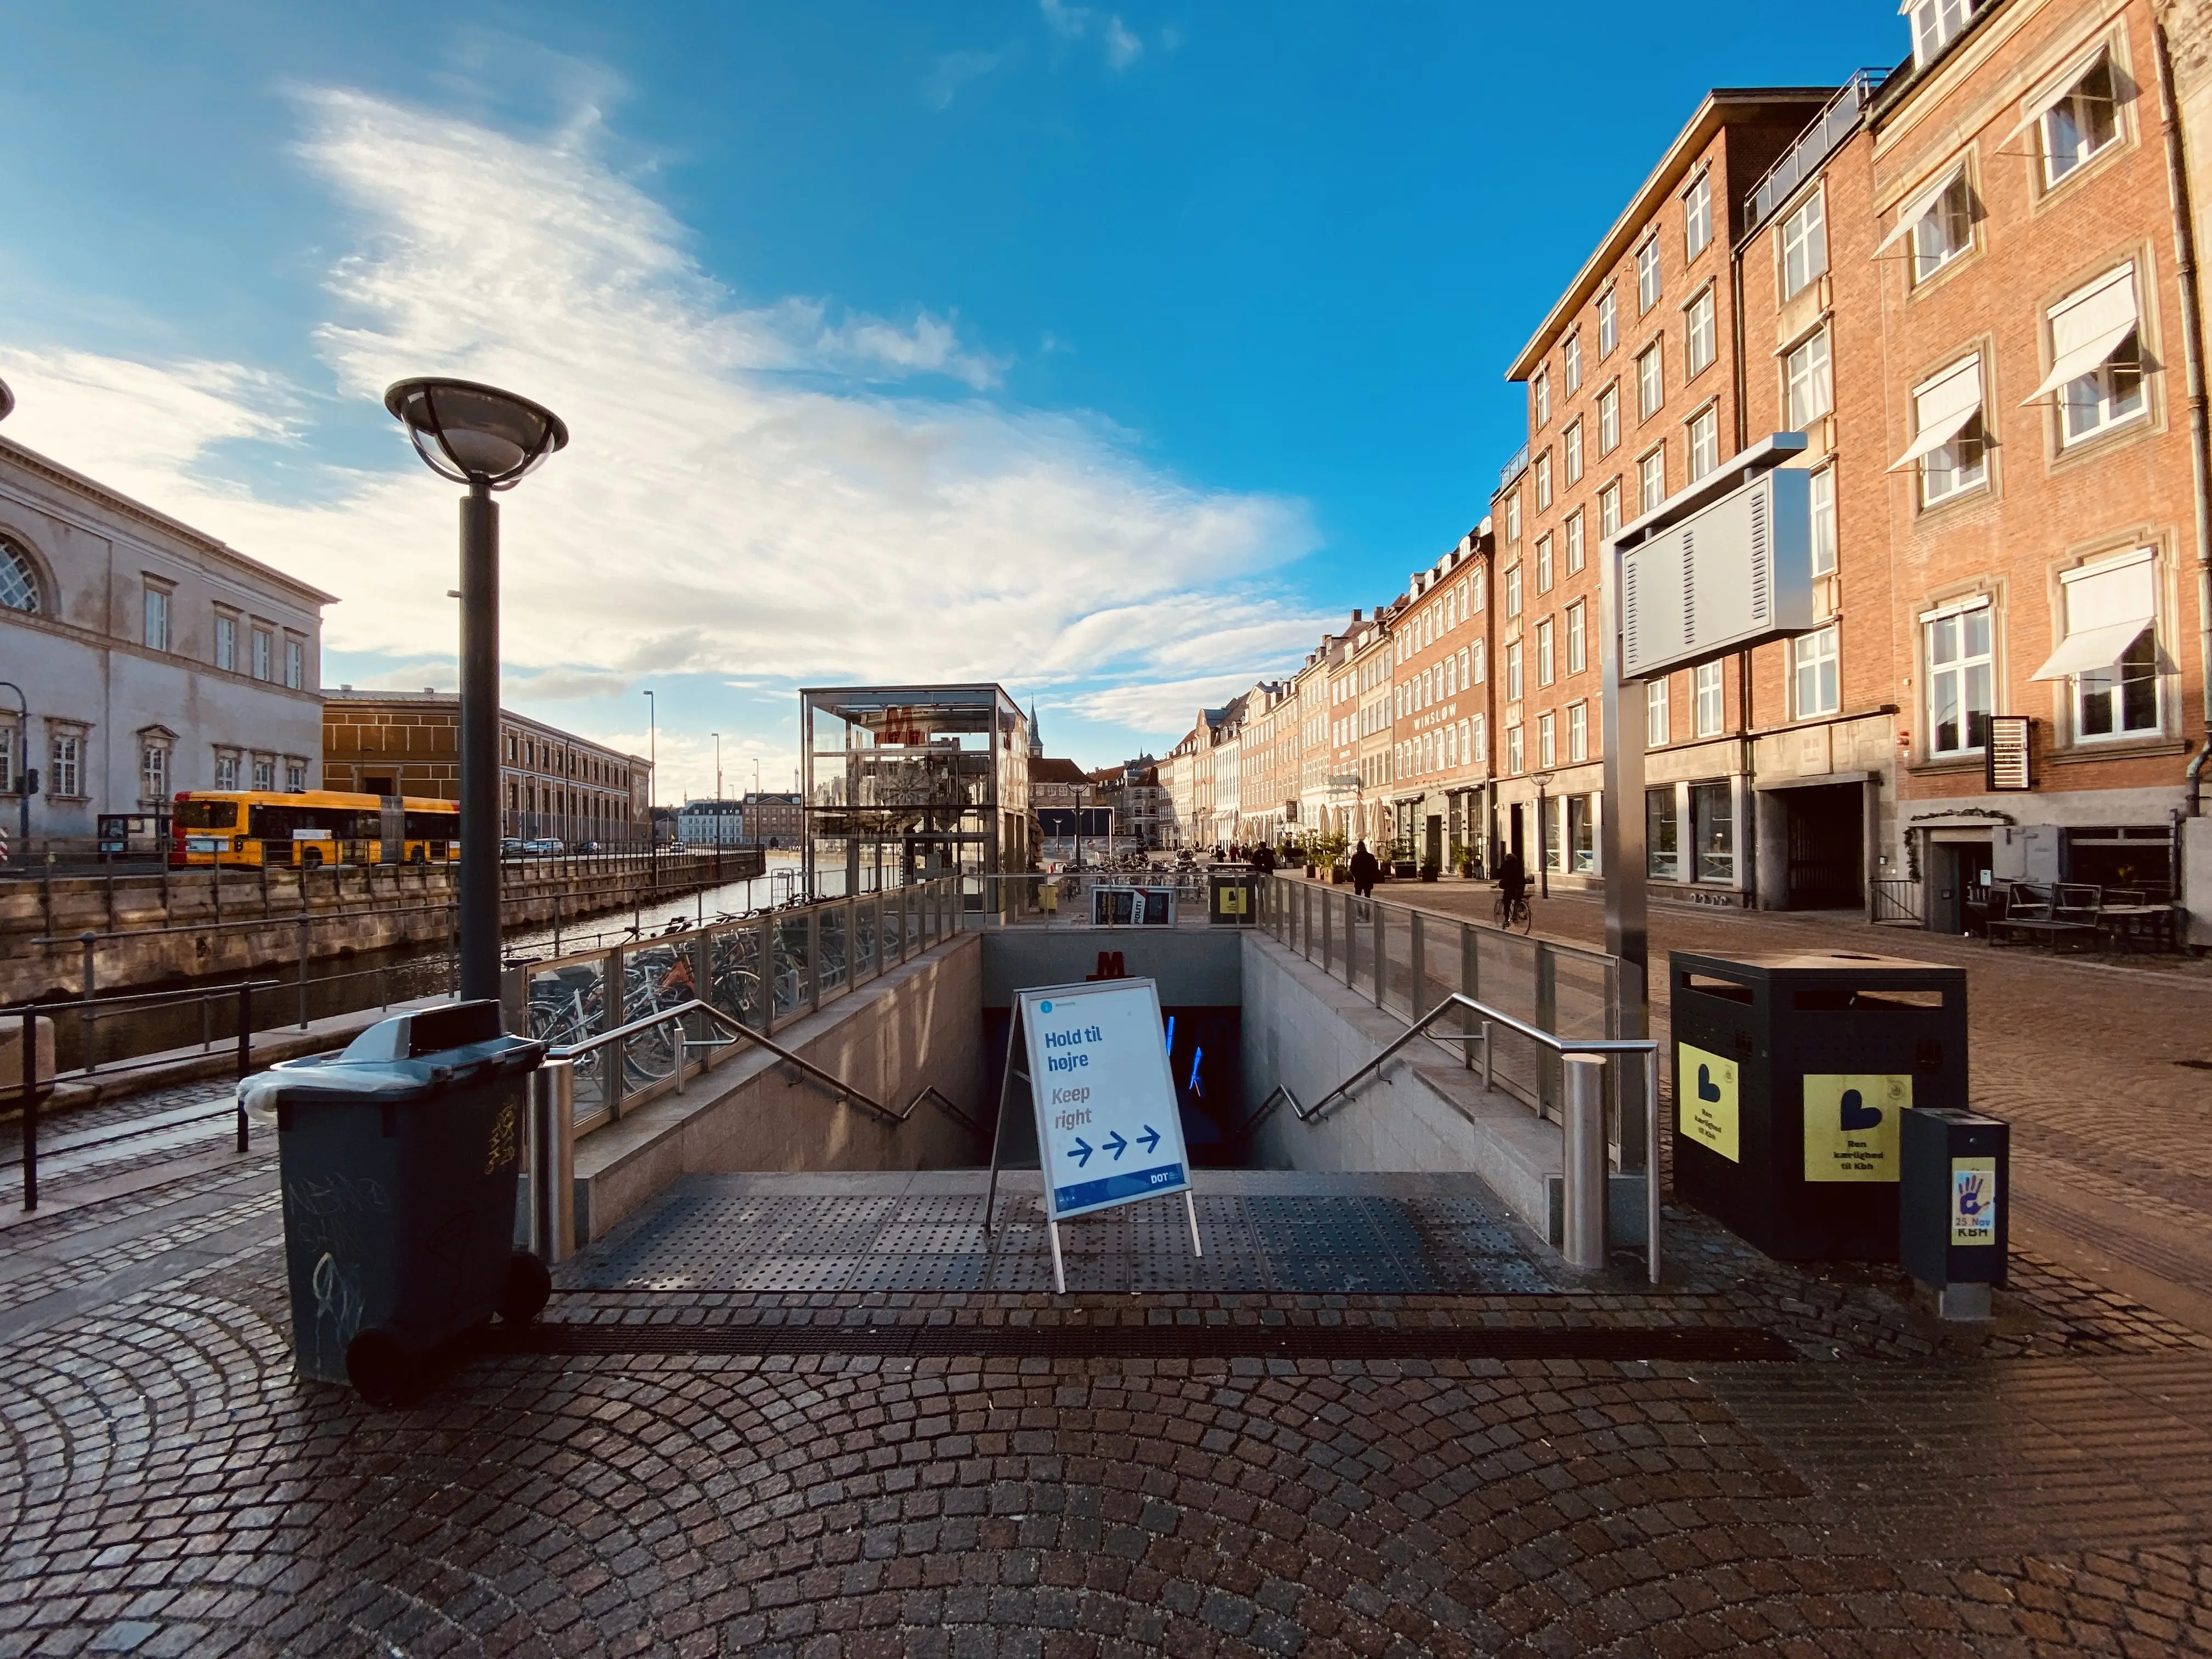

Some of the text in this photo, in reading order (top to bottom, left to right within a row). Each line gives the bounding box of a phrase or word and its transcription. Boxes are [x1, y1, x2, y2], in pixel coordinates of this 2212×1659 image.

[1413, 702, 1457, 731] WINSLØW
[1097, 951, 1125, 976] M
[1045, 1025, 1103, 1048] Hold til
[1048, 1052, 1089, 1072] højre
[1052, 1087, 1090, 1104] Keep
[1055, 1108, 1092, 1130] right
[1150, 1172, 1169, 1184] DOT
[1972, 1217, 1990, 1226] Nov
